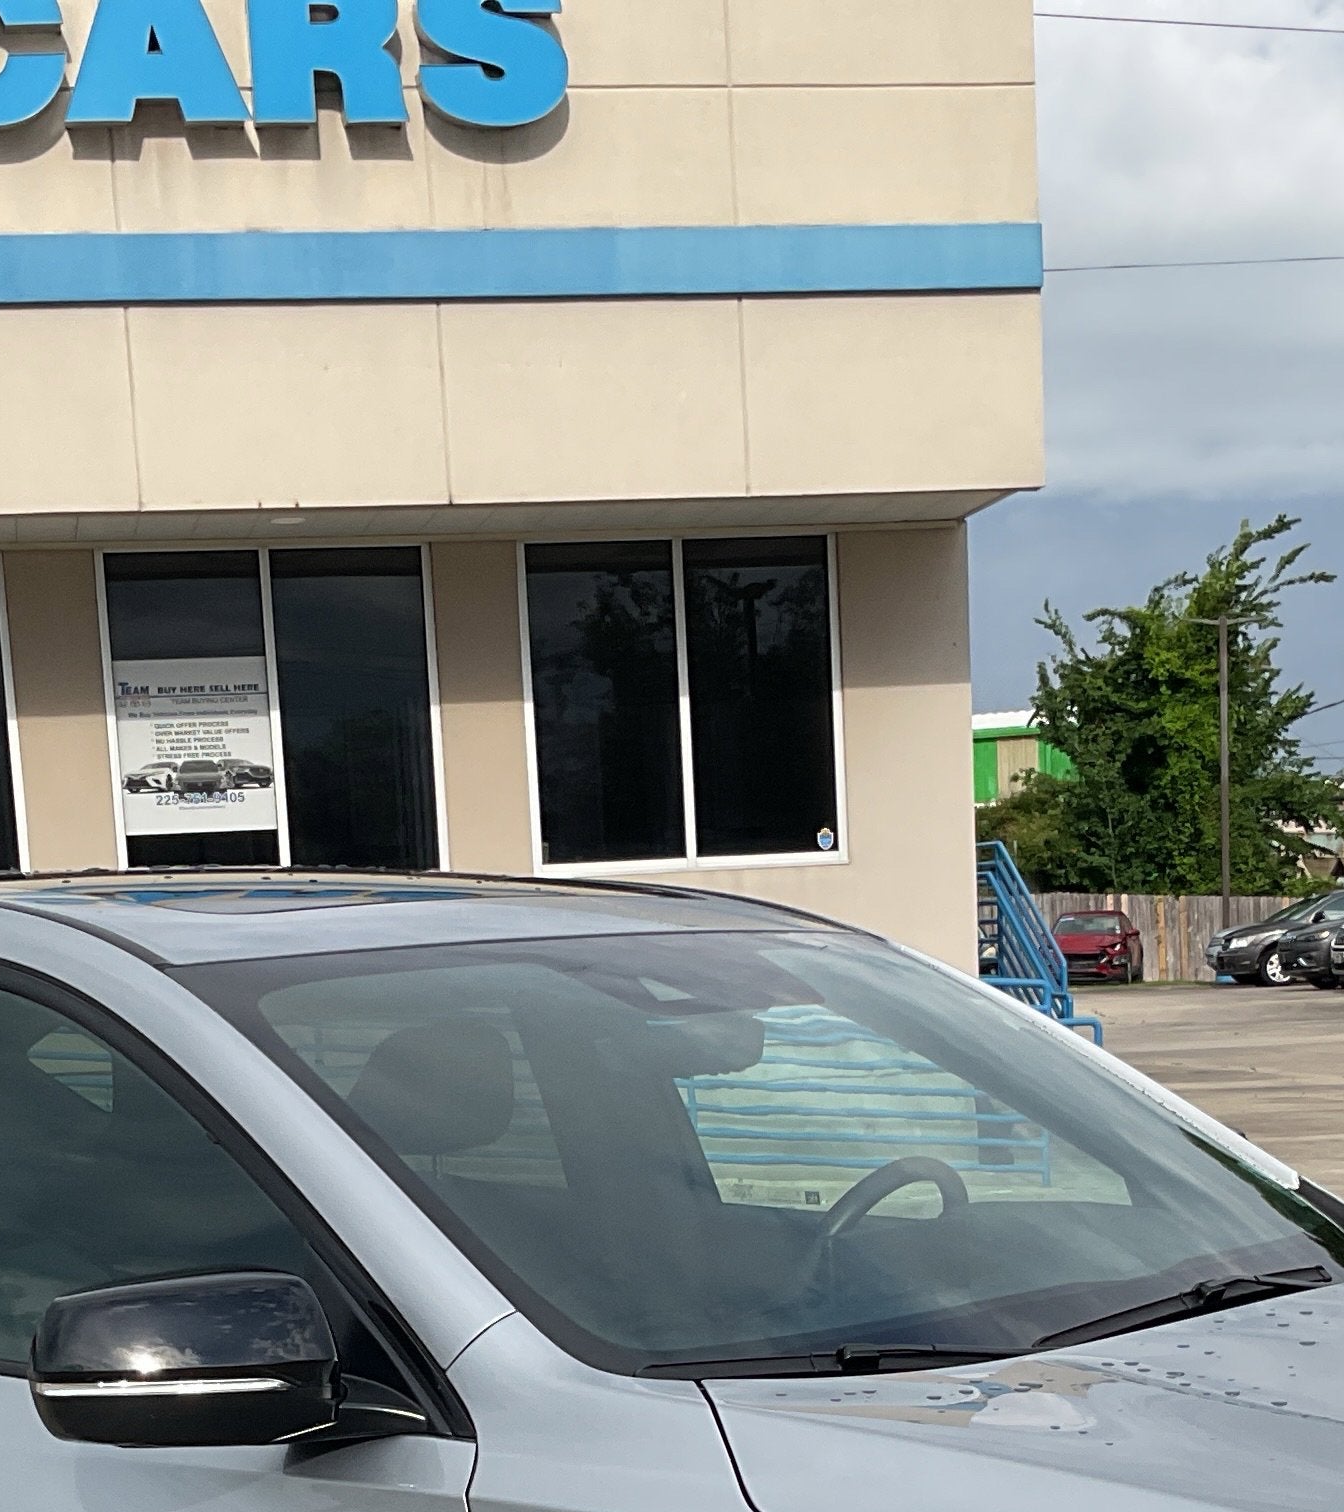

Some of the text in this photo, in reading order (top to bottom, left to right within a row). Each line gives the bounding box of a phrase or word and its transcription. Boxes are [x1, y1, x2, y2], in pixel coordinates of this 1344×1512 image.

[158, 686, 176, 694] BUY
[180, 685, 206, 694] HERE
[210, 684, 231, 692] SELL
[234, 683, 260, 692] HERE
